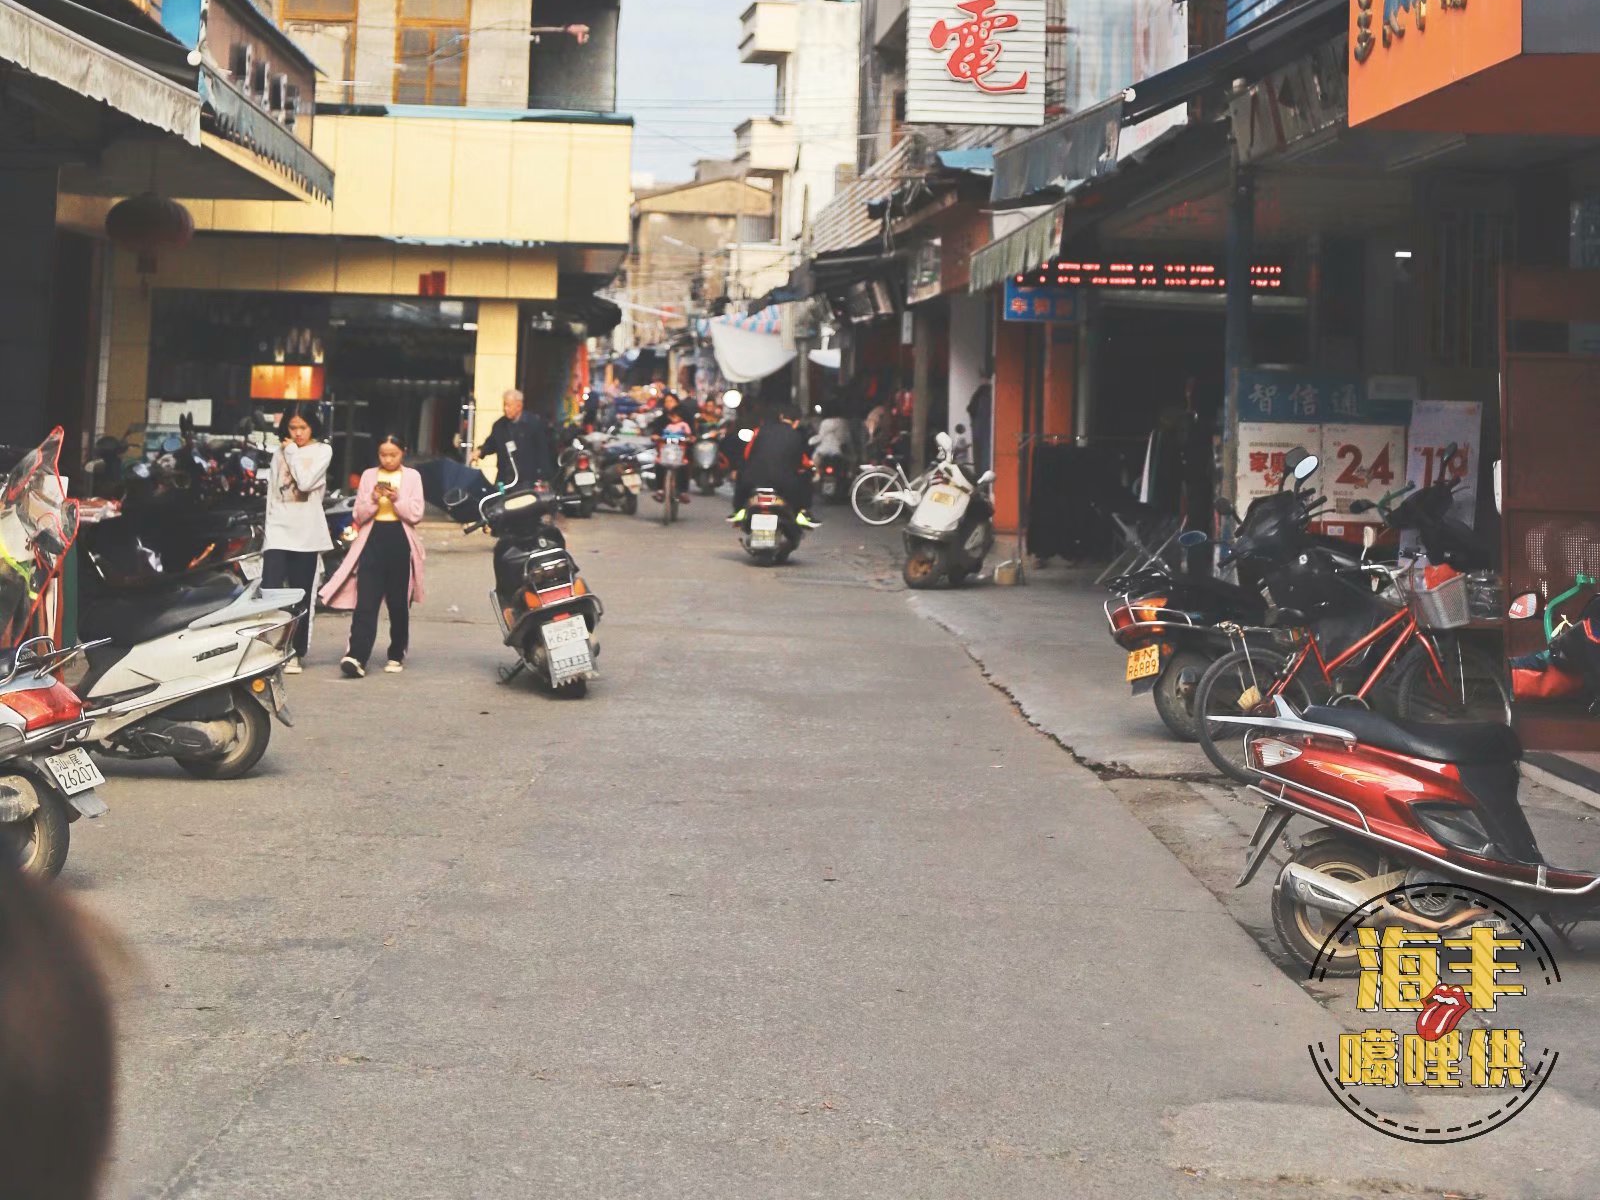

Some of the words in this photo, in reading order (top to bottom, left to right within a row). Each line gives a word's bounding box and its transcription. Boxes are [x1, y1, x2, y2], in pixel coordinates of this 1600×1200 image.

[1248, 383, 1361, 417] 智信通
[58, 763, 98, 790] 26207
